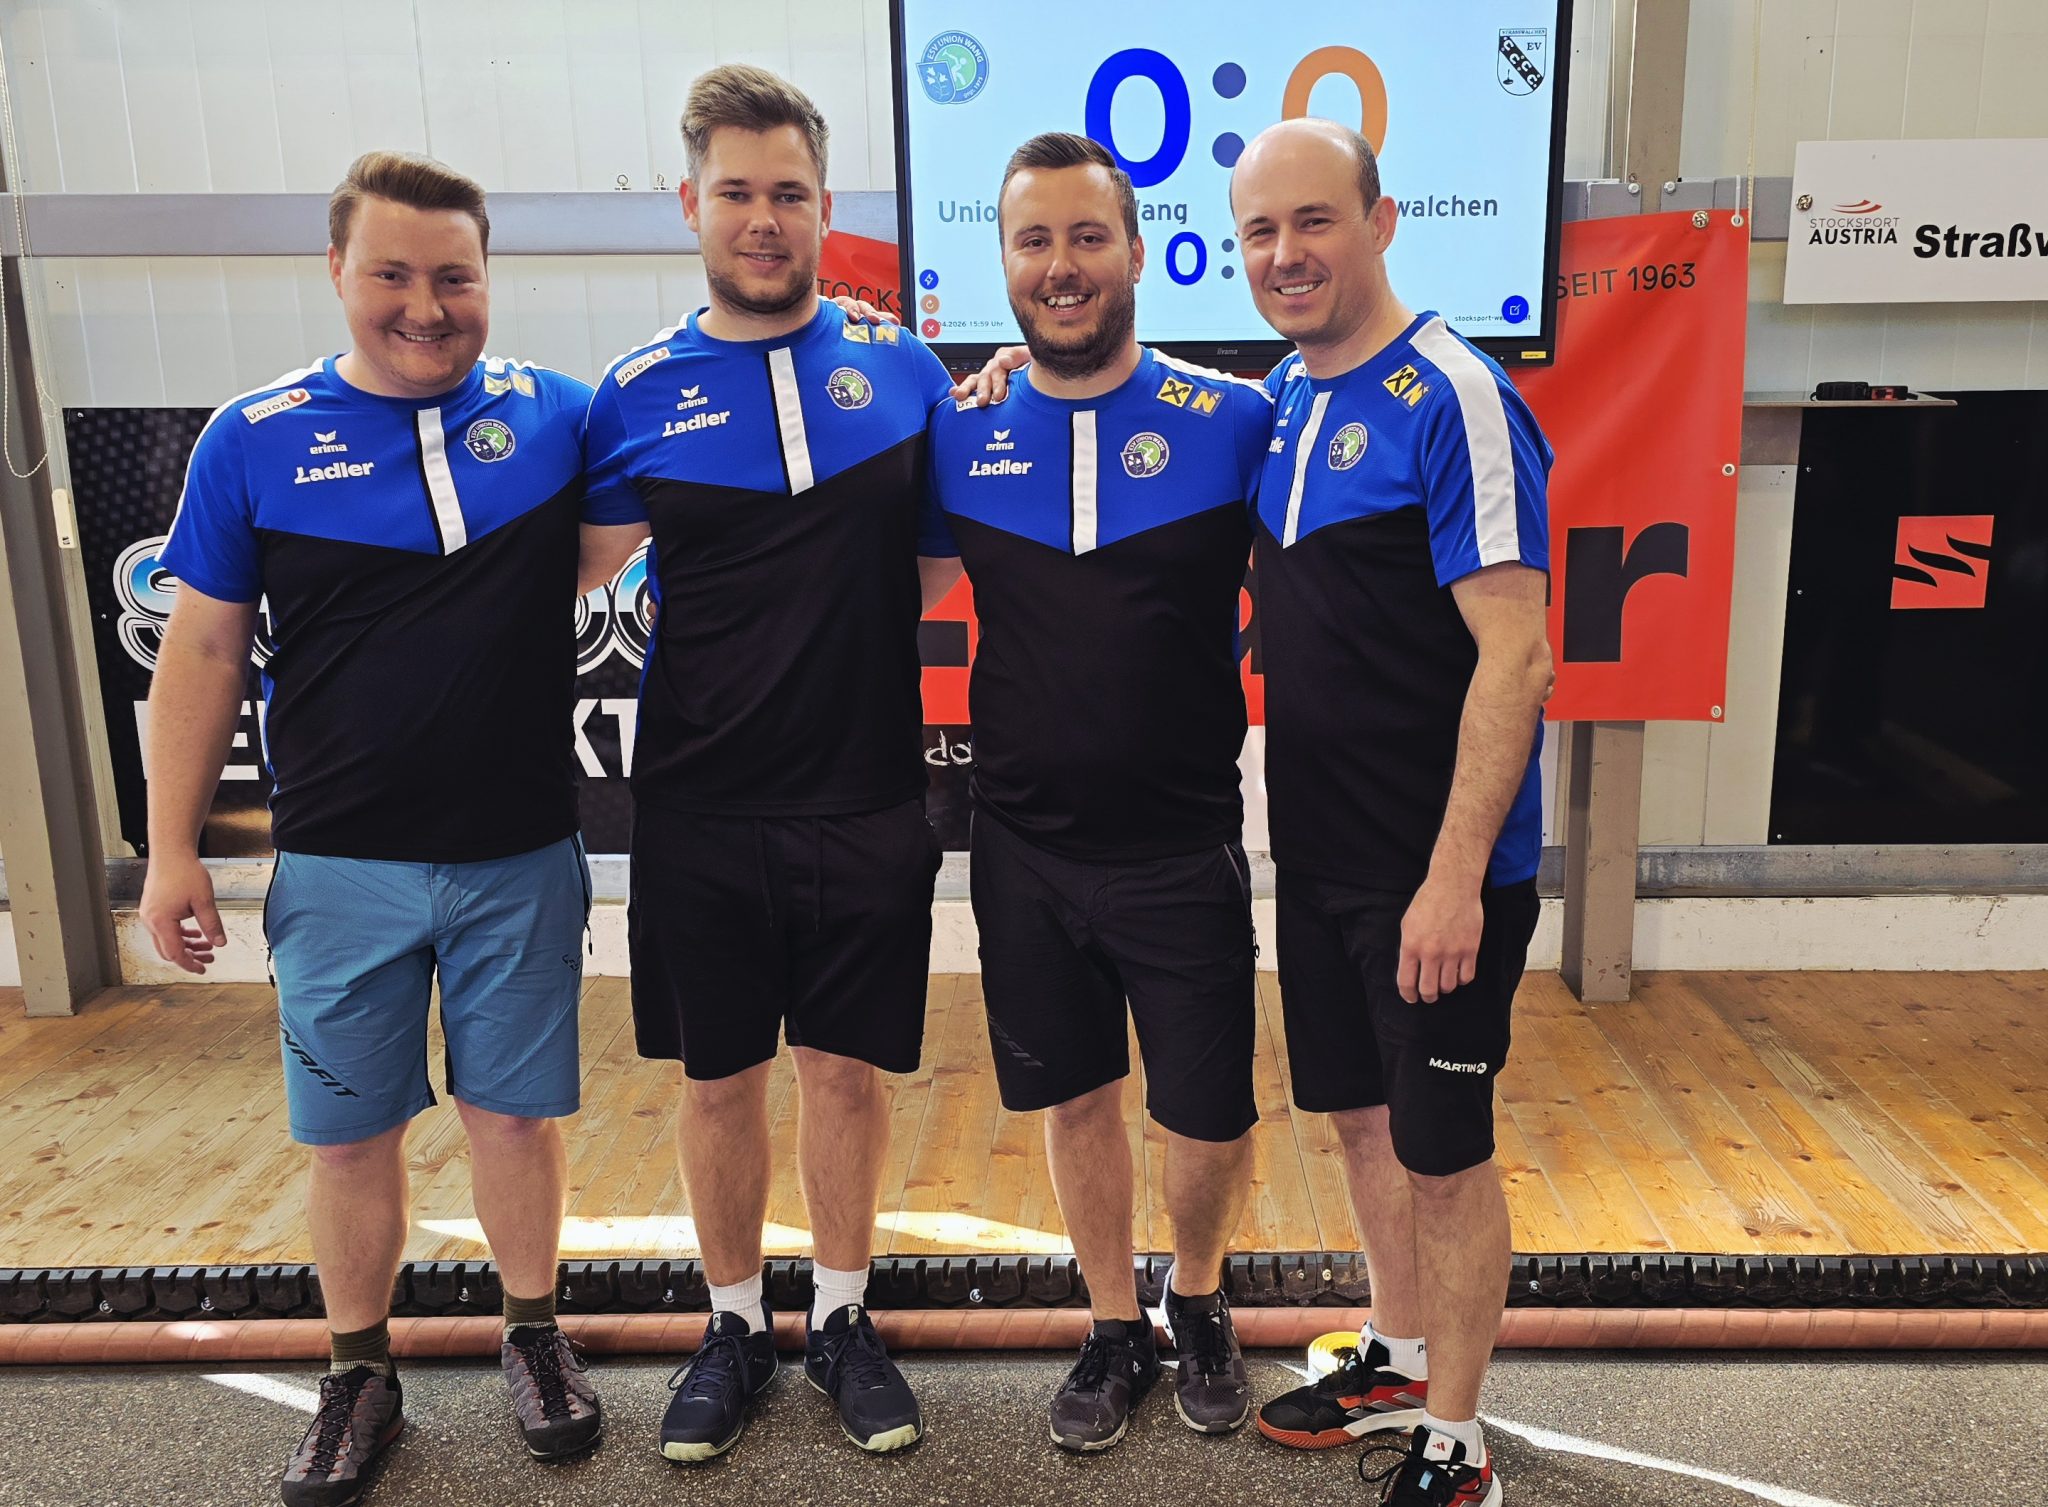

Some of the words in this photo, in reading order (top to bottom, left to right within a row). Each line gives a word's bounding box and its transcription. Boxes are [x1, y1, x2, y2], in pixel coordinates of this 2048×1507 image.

[937, 35, 964, 46] UNION
[964, 38, 984, 63] WANG
[1526, 42, 1542, 51] EV
[938, 200, 997, 223] Unio
[1138, 199, 1188, 225] ang
[1397, 194, 1499, 218] walchen
[1809, 217, 1901, 229] STOCKSPORT
[1808, 228, 1898, 245] AUSTRIA
[1627, 262, 1696, 292] 1963
[618, 358, 652, 385] union
[247, 400, 291, 421] union
[676, 396, 709, 411] erima
[662, 410, 731, 438] Ladler
[309, 443, 349, 455] erima
[985, 441, 1015, 451] erima
[294, 461, 375, 485] Ladler
[968, 459, 1033, 477] Ladler
